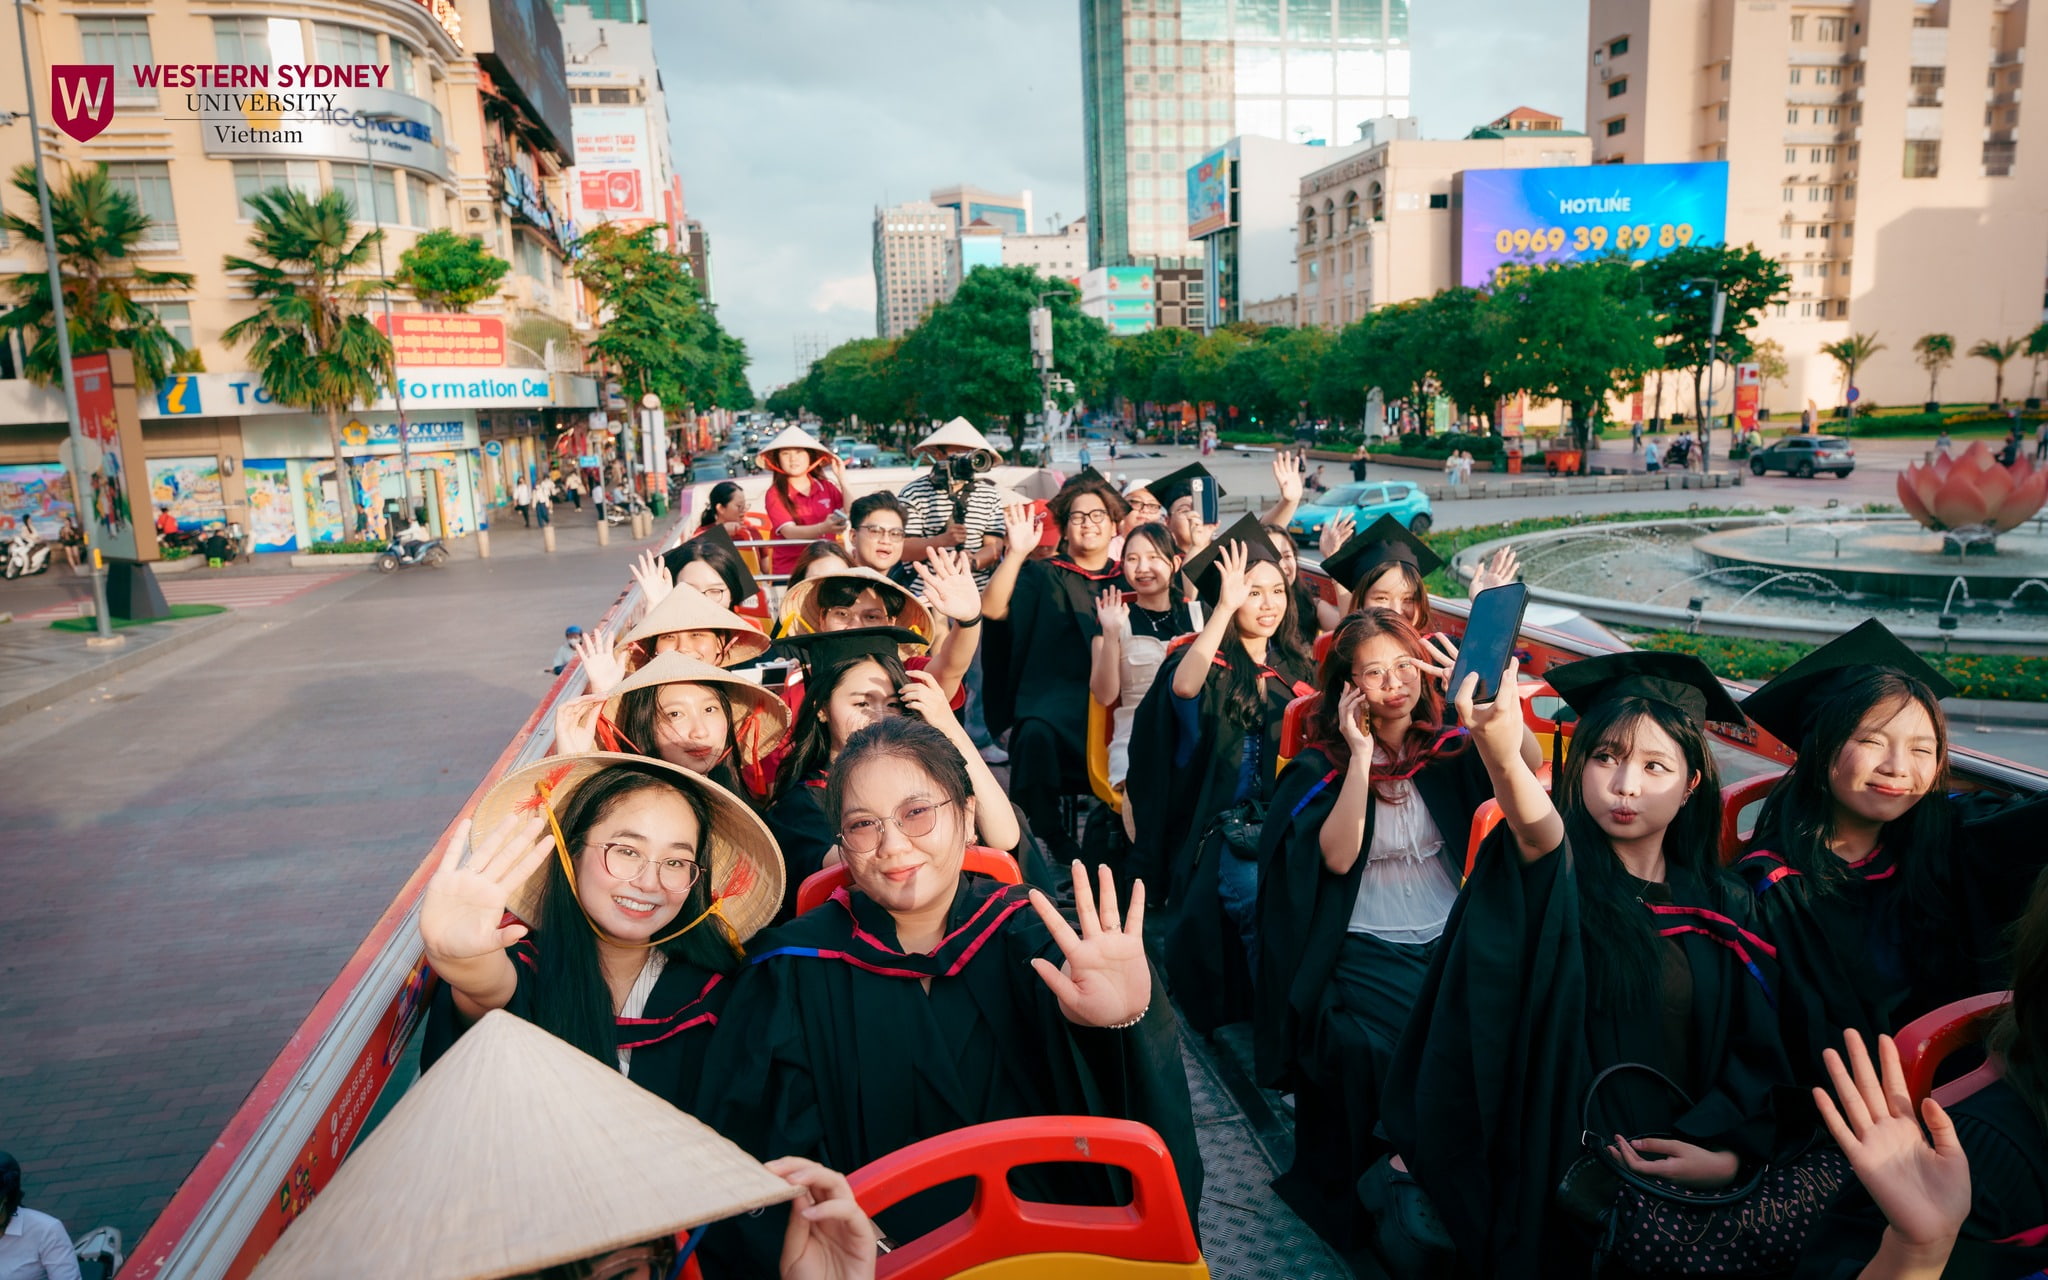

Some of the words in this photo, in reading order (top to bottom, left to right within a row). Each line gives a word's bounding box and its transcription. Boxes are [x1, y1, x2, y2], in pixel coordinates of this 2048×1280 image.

[295, 106, 432, 144] SAIGOOU
[1559, 197, 1631, 214] HOTLINE
[1495, 227, 1566, 254] 0969
[1572, 225, 1608, 251] 39
[1615, 224, 1651, 250] 89
[1658, 222, 1693, 249] 89
[375, 378, 517, 400] nformation
[374, 421, 464, 438] SAONTOU
